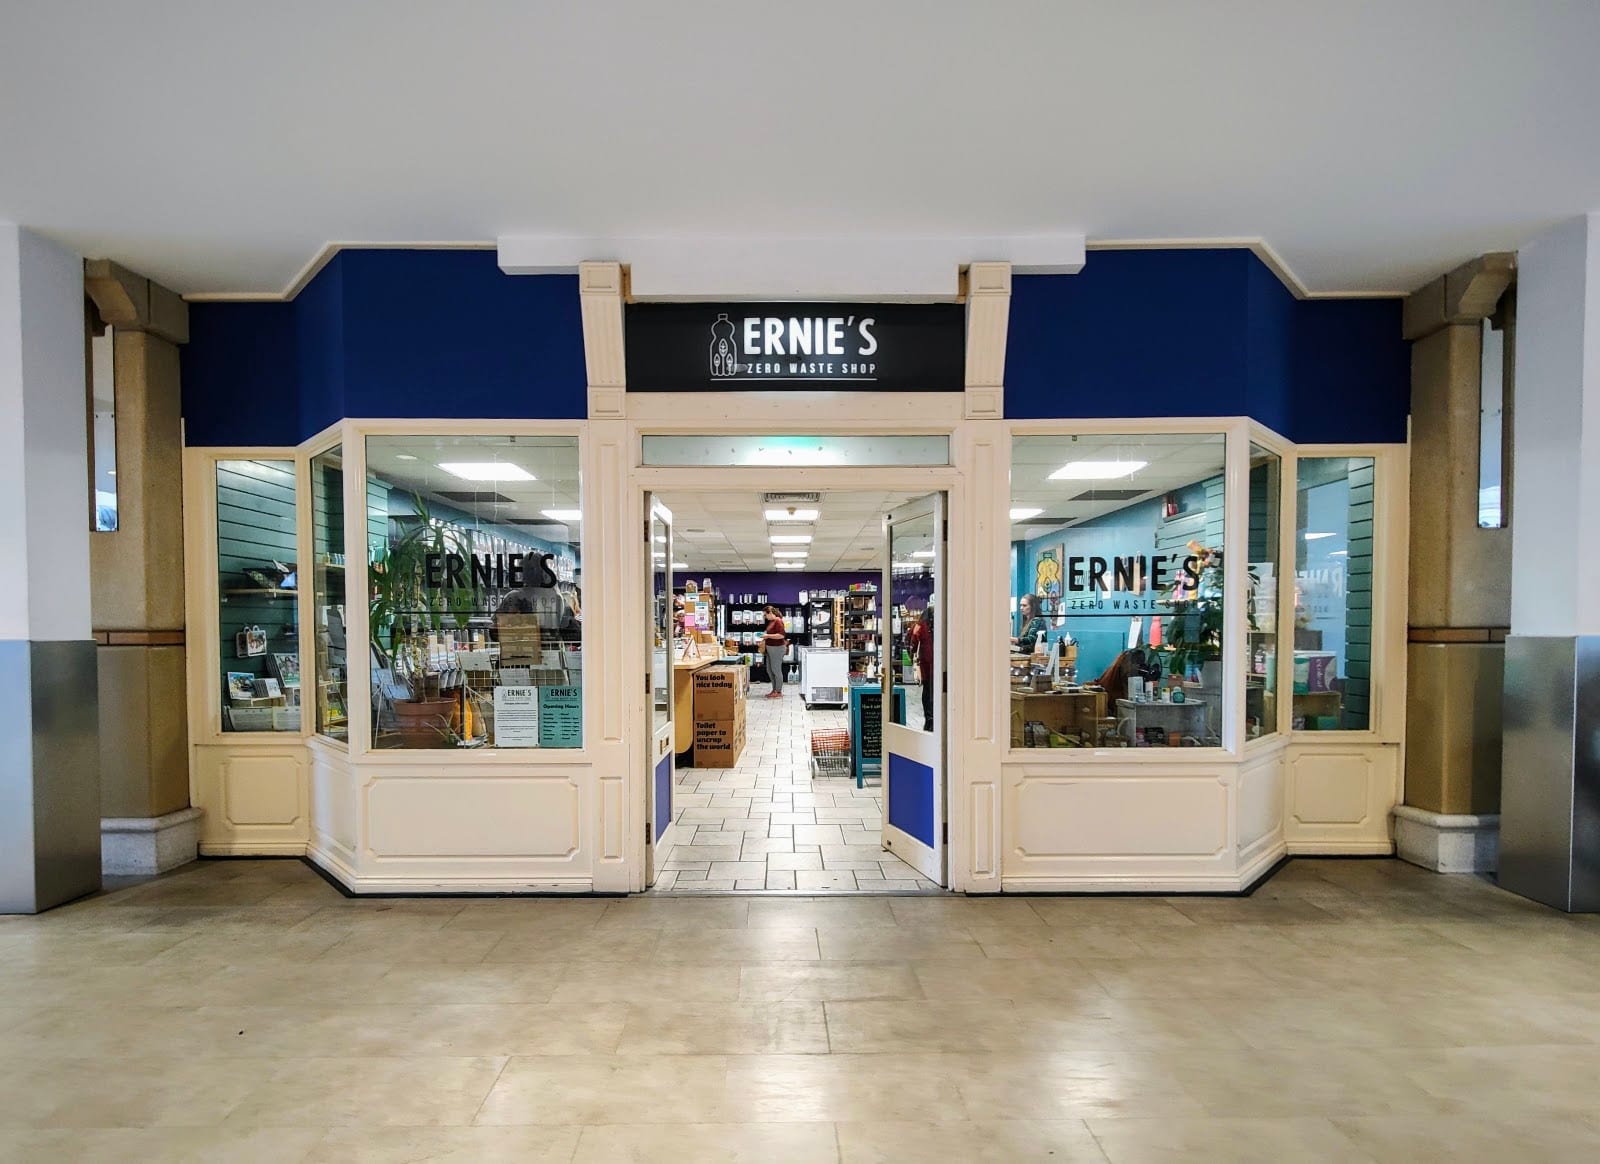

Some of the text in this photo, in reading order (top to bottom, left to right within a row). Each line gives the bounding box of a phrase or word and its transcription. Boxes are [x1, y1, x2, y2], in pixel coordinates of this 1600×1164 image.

[743, 315, 878, 356] ERNIE'S
[747, 363, 876, 374] ZERO WASTE SHOP
[425, 552, 557, 589] ERNIE'S
[1068, 553, 1200, 591] ERNIE'S
[430, 596, 461, 607] ZERO
[1071, 599, 1104, 610] ZERO
[1113, 599, 1156, 610] WASTE
[712, 681, 732, 689] today
[507, 689, 531, 697] ERNIE'S
[550, 688, 577, 697] ERNIE'S
